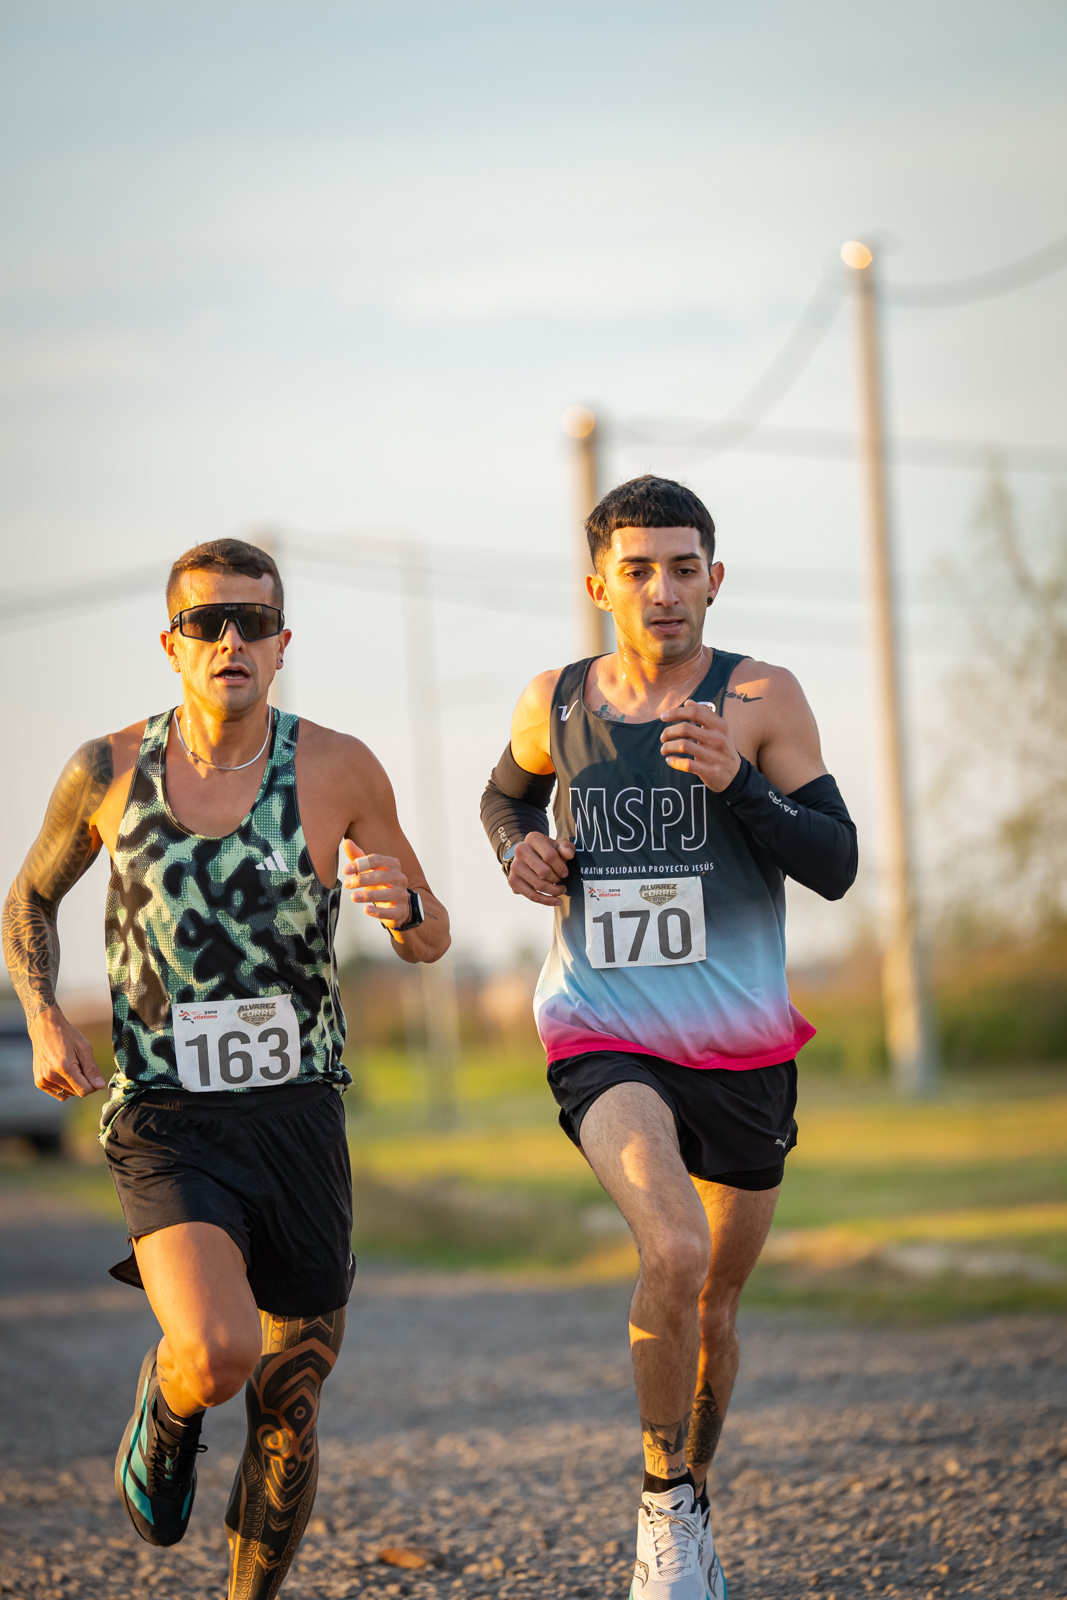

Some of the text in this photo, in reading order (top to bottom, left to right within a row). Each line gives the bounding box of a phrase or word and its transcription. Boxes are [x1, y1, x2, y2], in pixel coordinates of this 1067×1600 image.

[569, 784, 707, 852] MSPJ
[605, 865, 647, 875] SOLIDARIA
[648, 864, 690, 873] PROYECTO
[691, 861, 714, 872] JESÚS
[639, 883, 678, 892] ALVAREZ
[641, 889, 678, 898] CORRE
[592, 907, 692, 963] 170
[238, 1002, 277, 1012] ALVAREZ
[240, 1009, 276, 1018] CORRE
[185, 1027, 291, 1087] 163
